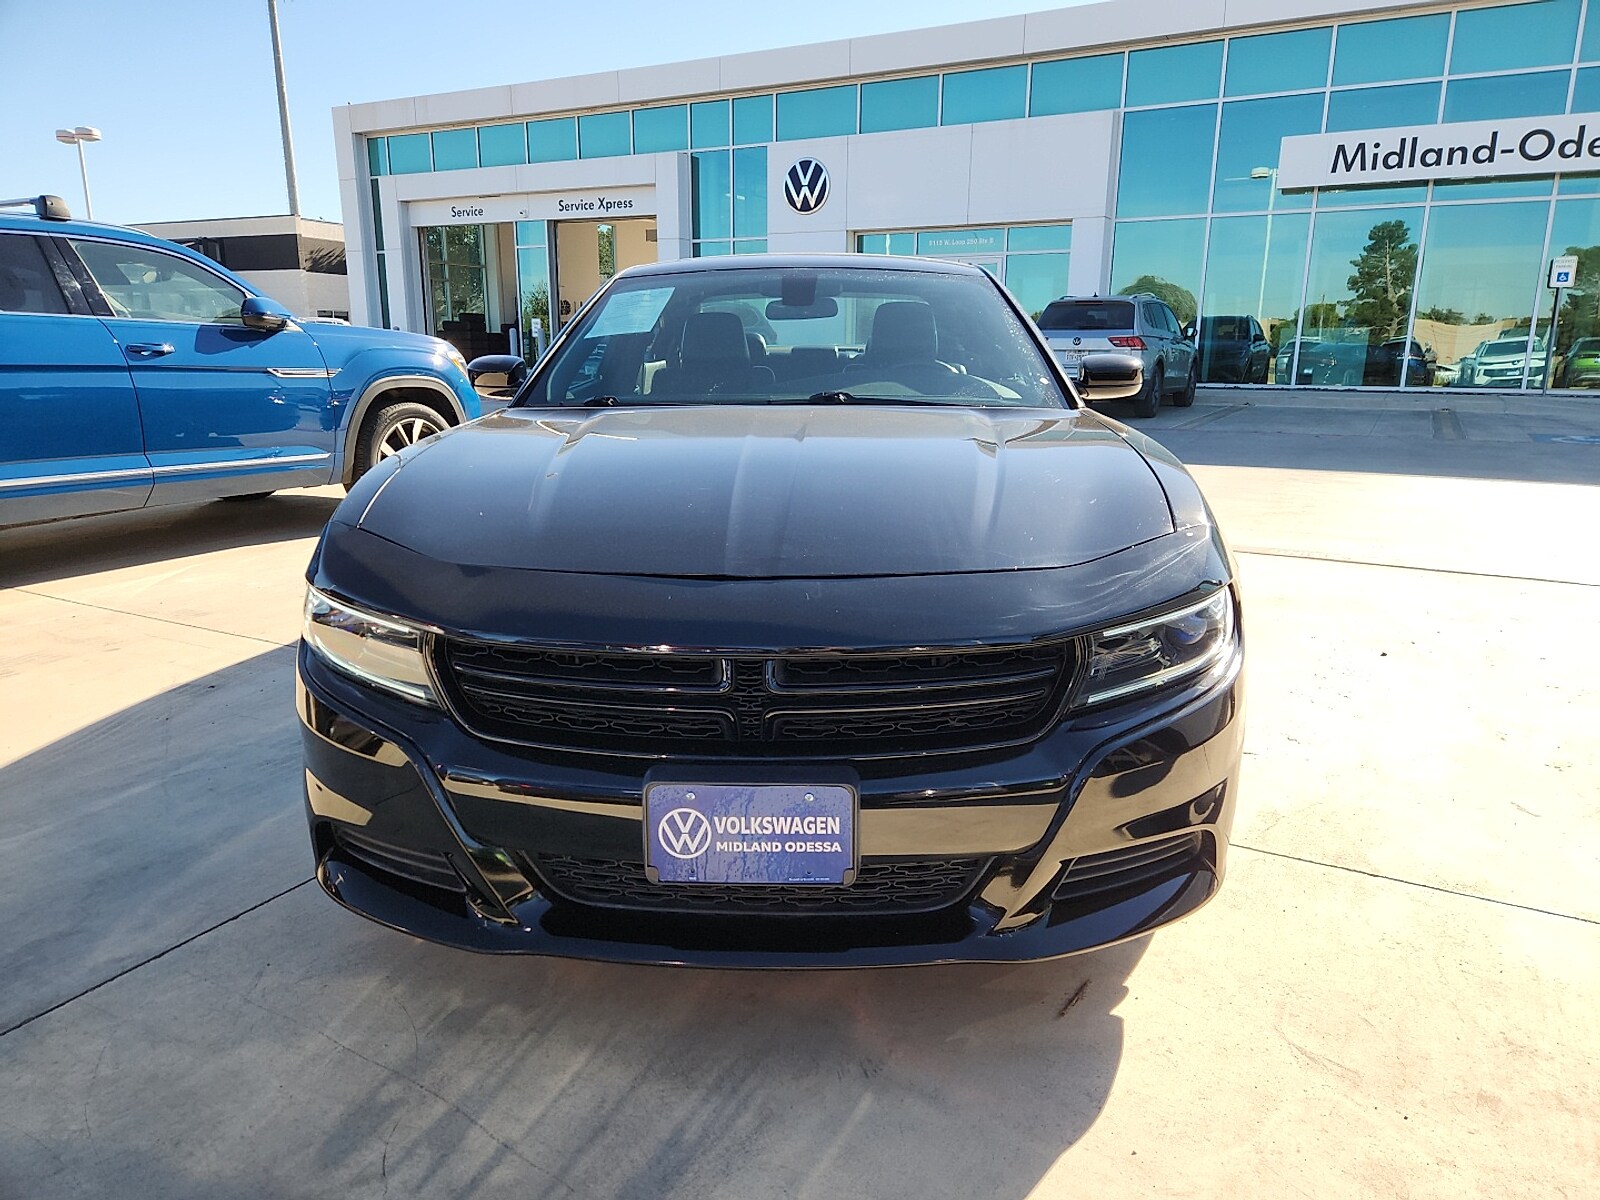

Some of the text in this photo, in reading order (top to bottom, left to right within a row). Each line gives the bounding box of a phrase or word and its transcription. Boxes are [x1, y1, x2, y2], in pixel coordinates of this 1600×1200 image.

[451, 206, 484, 218] Service
[558, 197, 634, 212] Service Xpress
[714, 816, 841, 835] VOLKSWAGEN
[658, 808, 712, 859] VW
[716, 841, 842, 853] MIDLAND ODESSA
